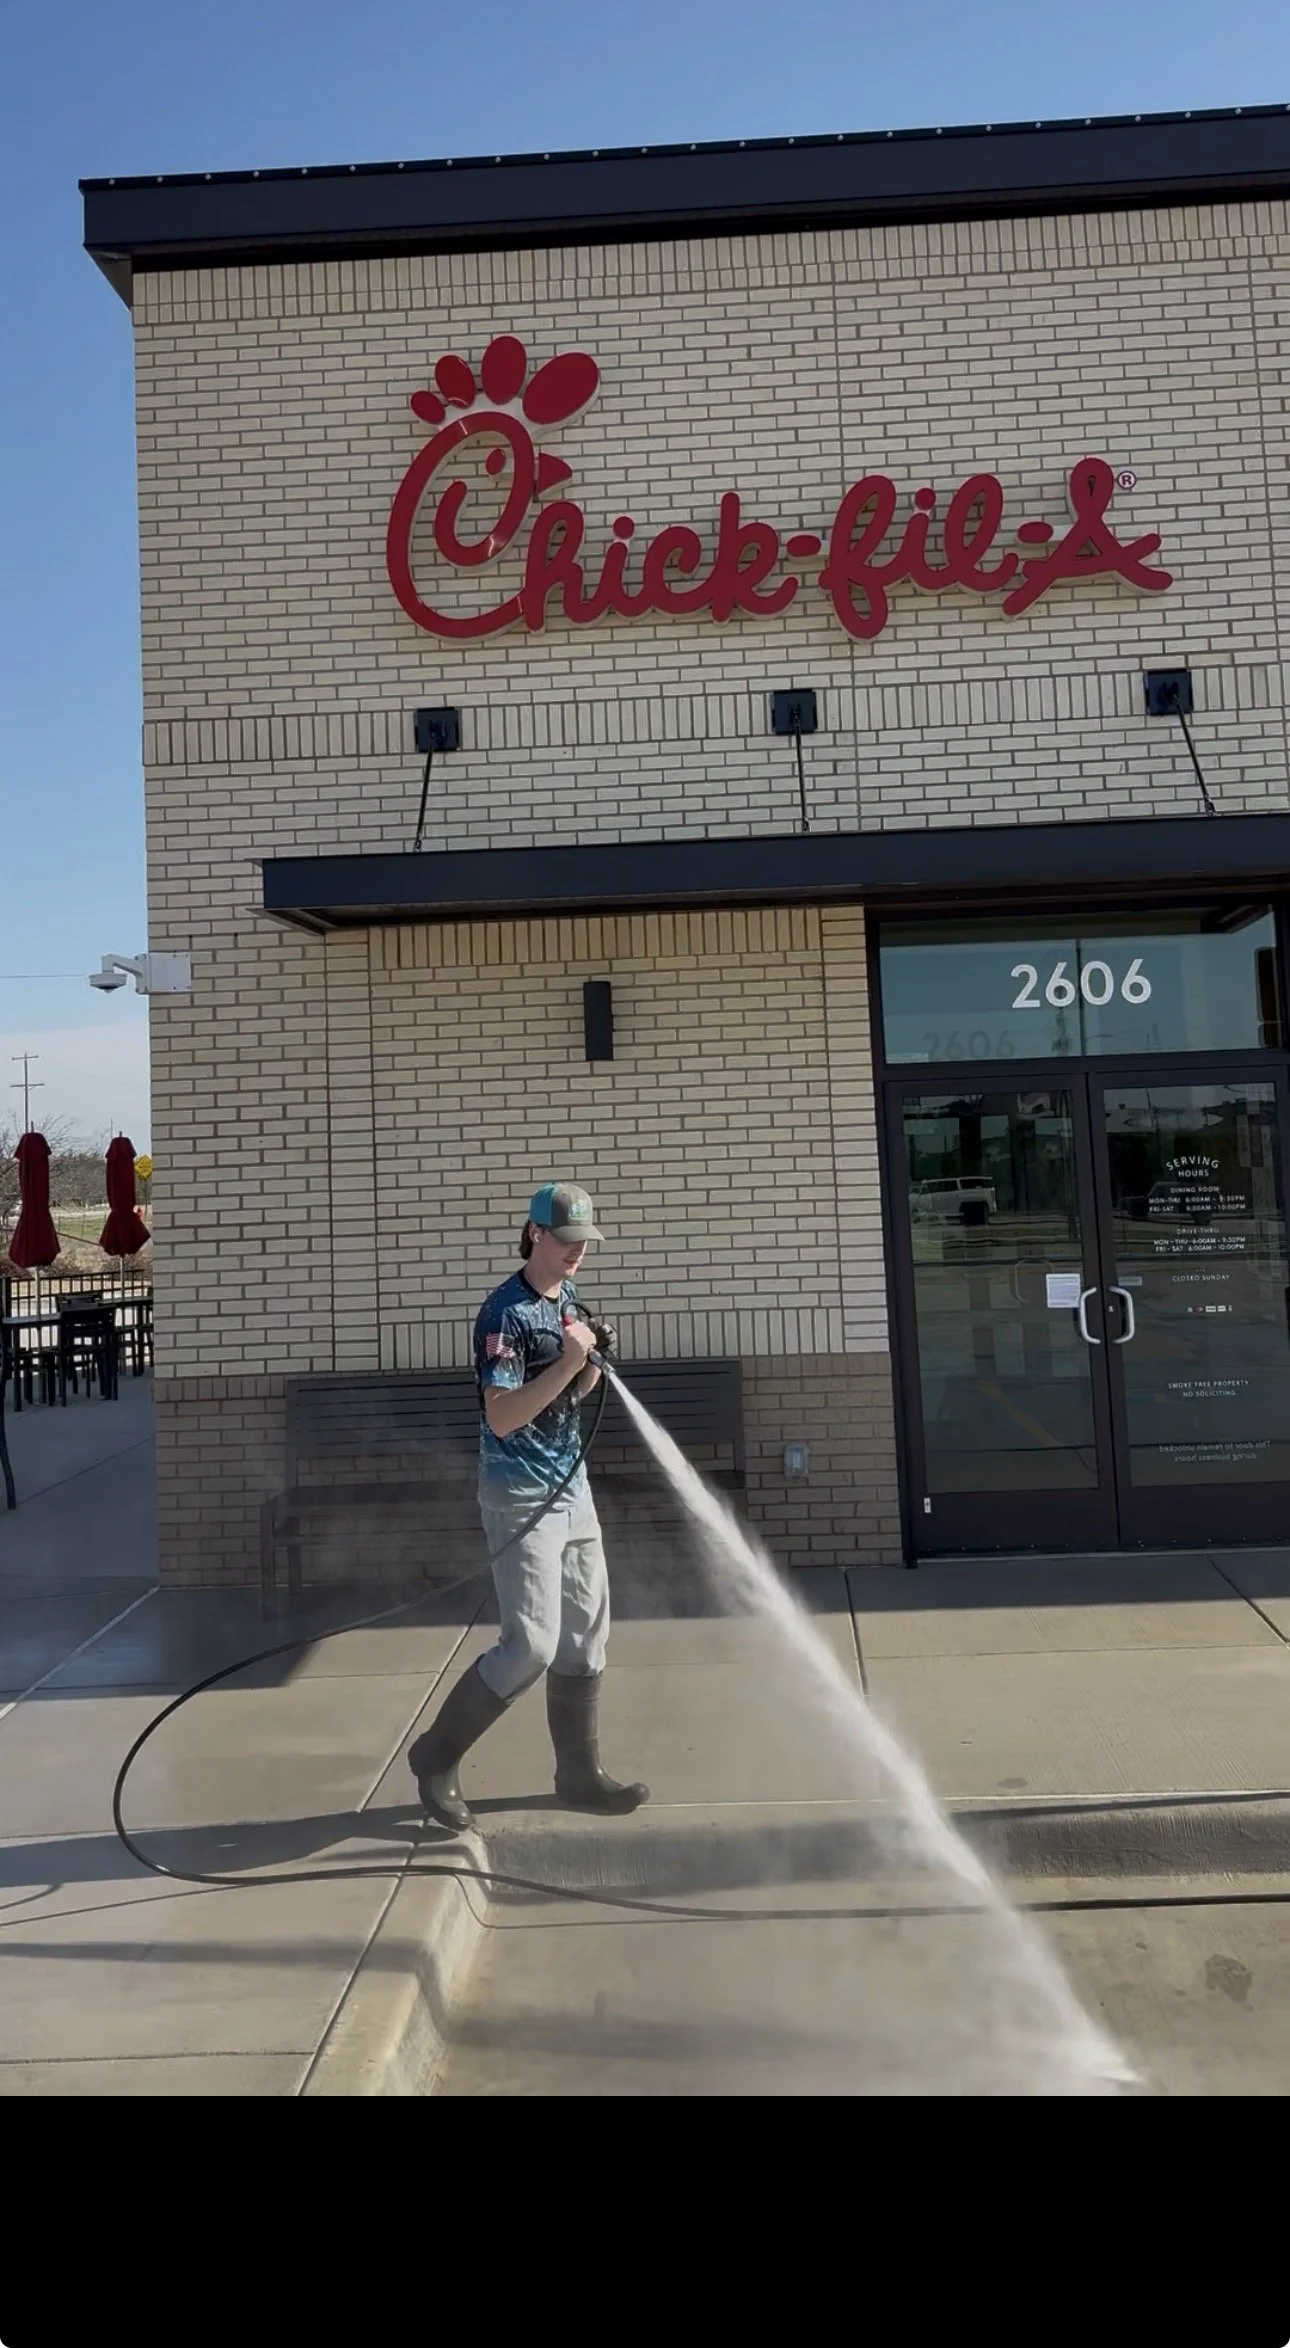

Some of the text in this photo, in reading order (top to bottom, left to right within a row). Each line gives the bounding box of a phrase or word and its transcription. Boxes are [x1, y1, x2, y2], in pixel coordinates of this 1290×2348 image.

[386, 411, 1173, 641] Chick-fil-A
[1011, 959, 1152, 1008] 2606
[1166, 1155, 1220, 1171] SERVING
[1178, 1169, 1210, 1177] HOURS
[1195, 1389, 1236, 1397] SOLICITING
